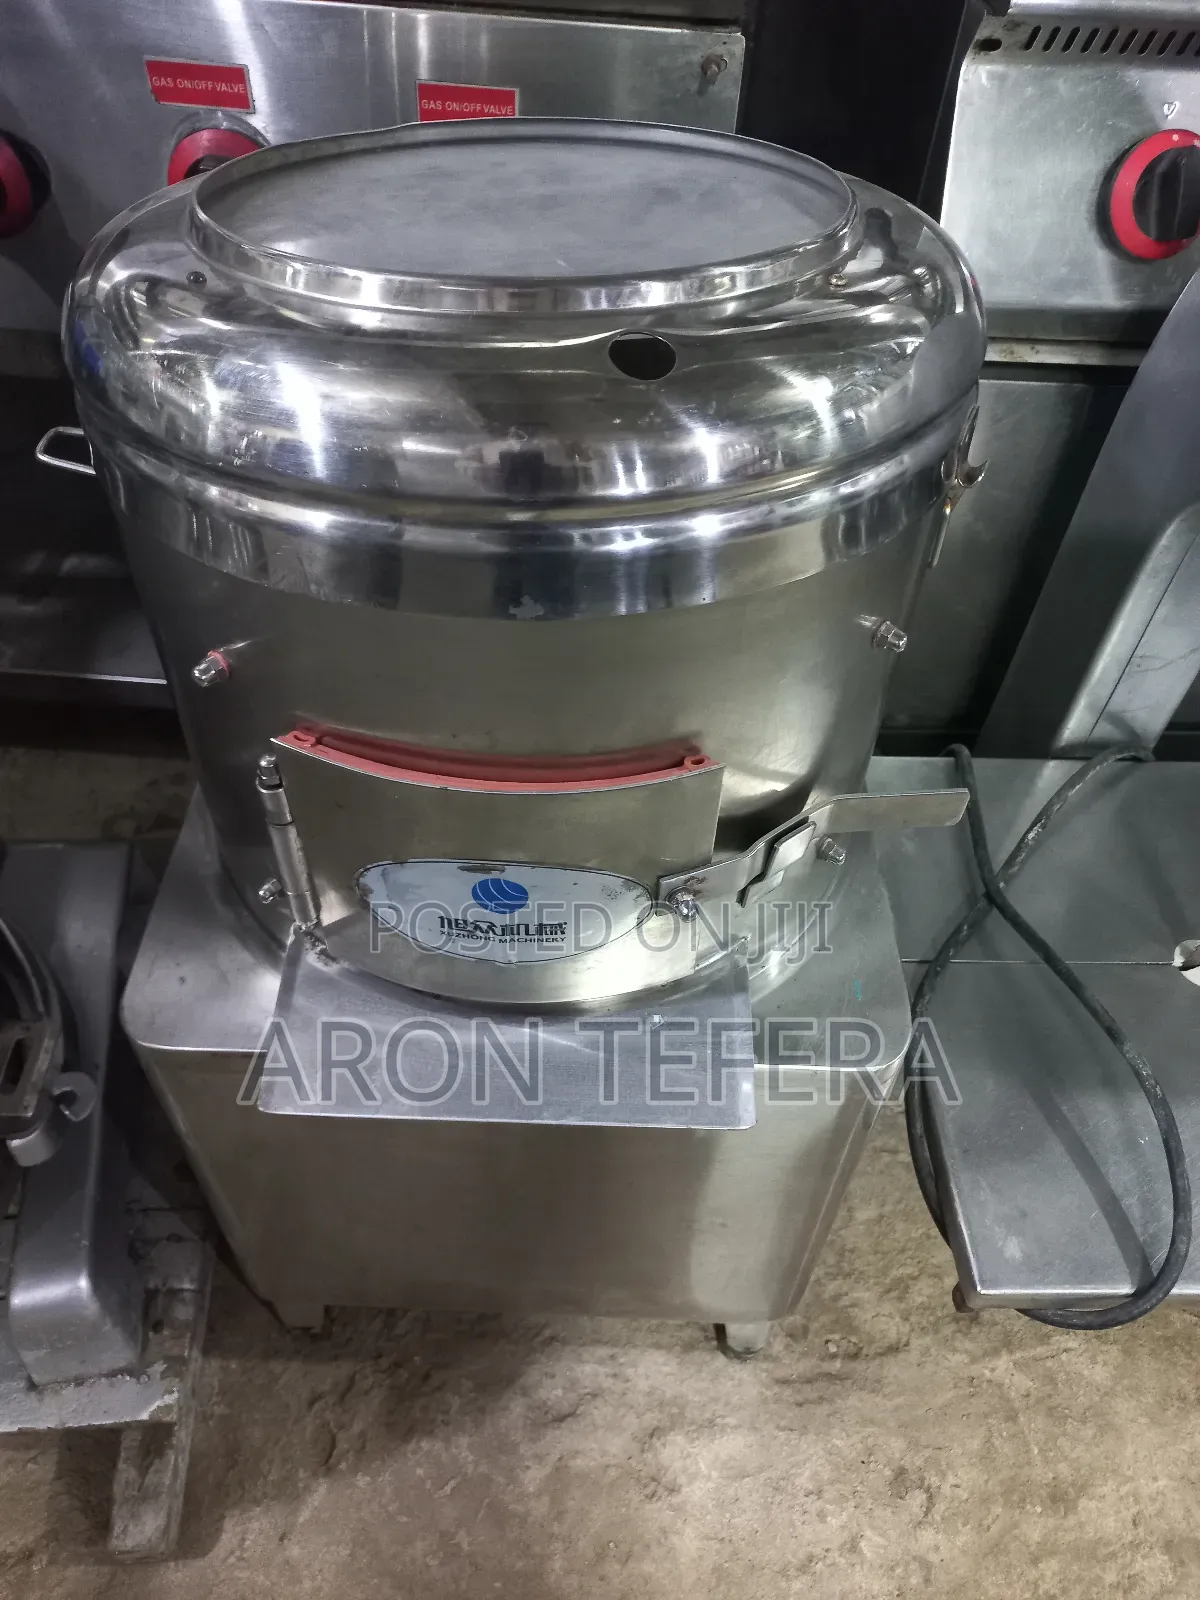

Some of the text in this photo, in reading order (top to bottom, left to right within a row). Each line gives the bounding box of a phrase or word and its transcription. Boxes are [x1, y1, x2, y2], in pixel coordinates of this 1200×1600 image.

[152, 75, 246, 94] GAS ON/OFF VALVE
[421, 99, 514, 116] GAS ON/OFF VALVE
[440, 929, 567, 944] XUZHONG MACHINERY
